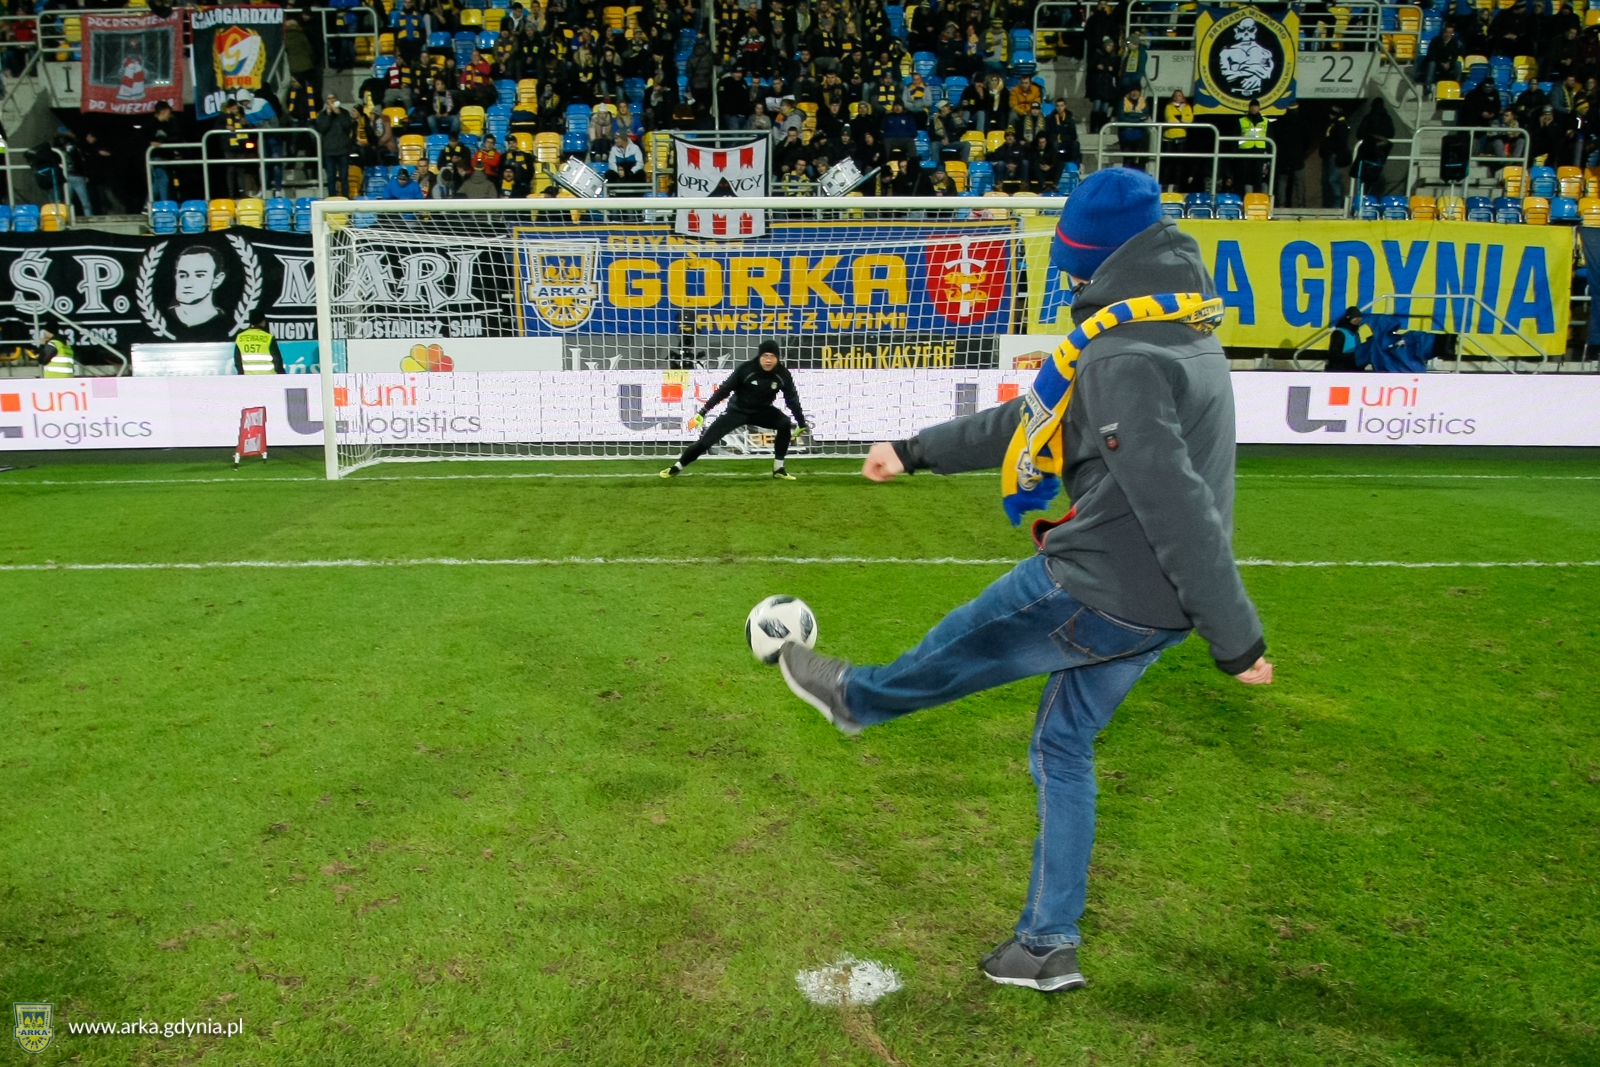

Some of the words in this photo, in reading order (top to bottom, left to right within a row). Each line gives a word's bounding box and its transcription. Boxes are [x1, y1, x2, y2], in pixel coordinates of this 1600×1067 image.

[1320, 55, 1354, 83] 22
[272, 250, 483, 313] MARI
[538, 287, 587, 297] ARKA
[1279, 239, 1556, 335] GDYNIA
[268, 321, 315, 340] NIGDY
[450, 318, 483, 338] SAM
[828, 312, 907, 330] WAMI
[239, 334, 268, 343] STEWARD
[244, 344, 261, 354] 057
[821, 345, 874, 369] Radio
[32, 382, 88, 412] uni
[360, 376, 417, 407] uni
[1360, 378, 1419, 407] uni
[33, 413, 152, 445] logistics
[361, 412, 482, 440] logistics
[1357, 407, 1476, 440] logistics
